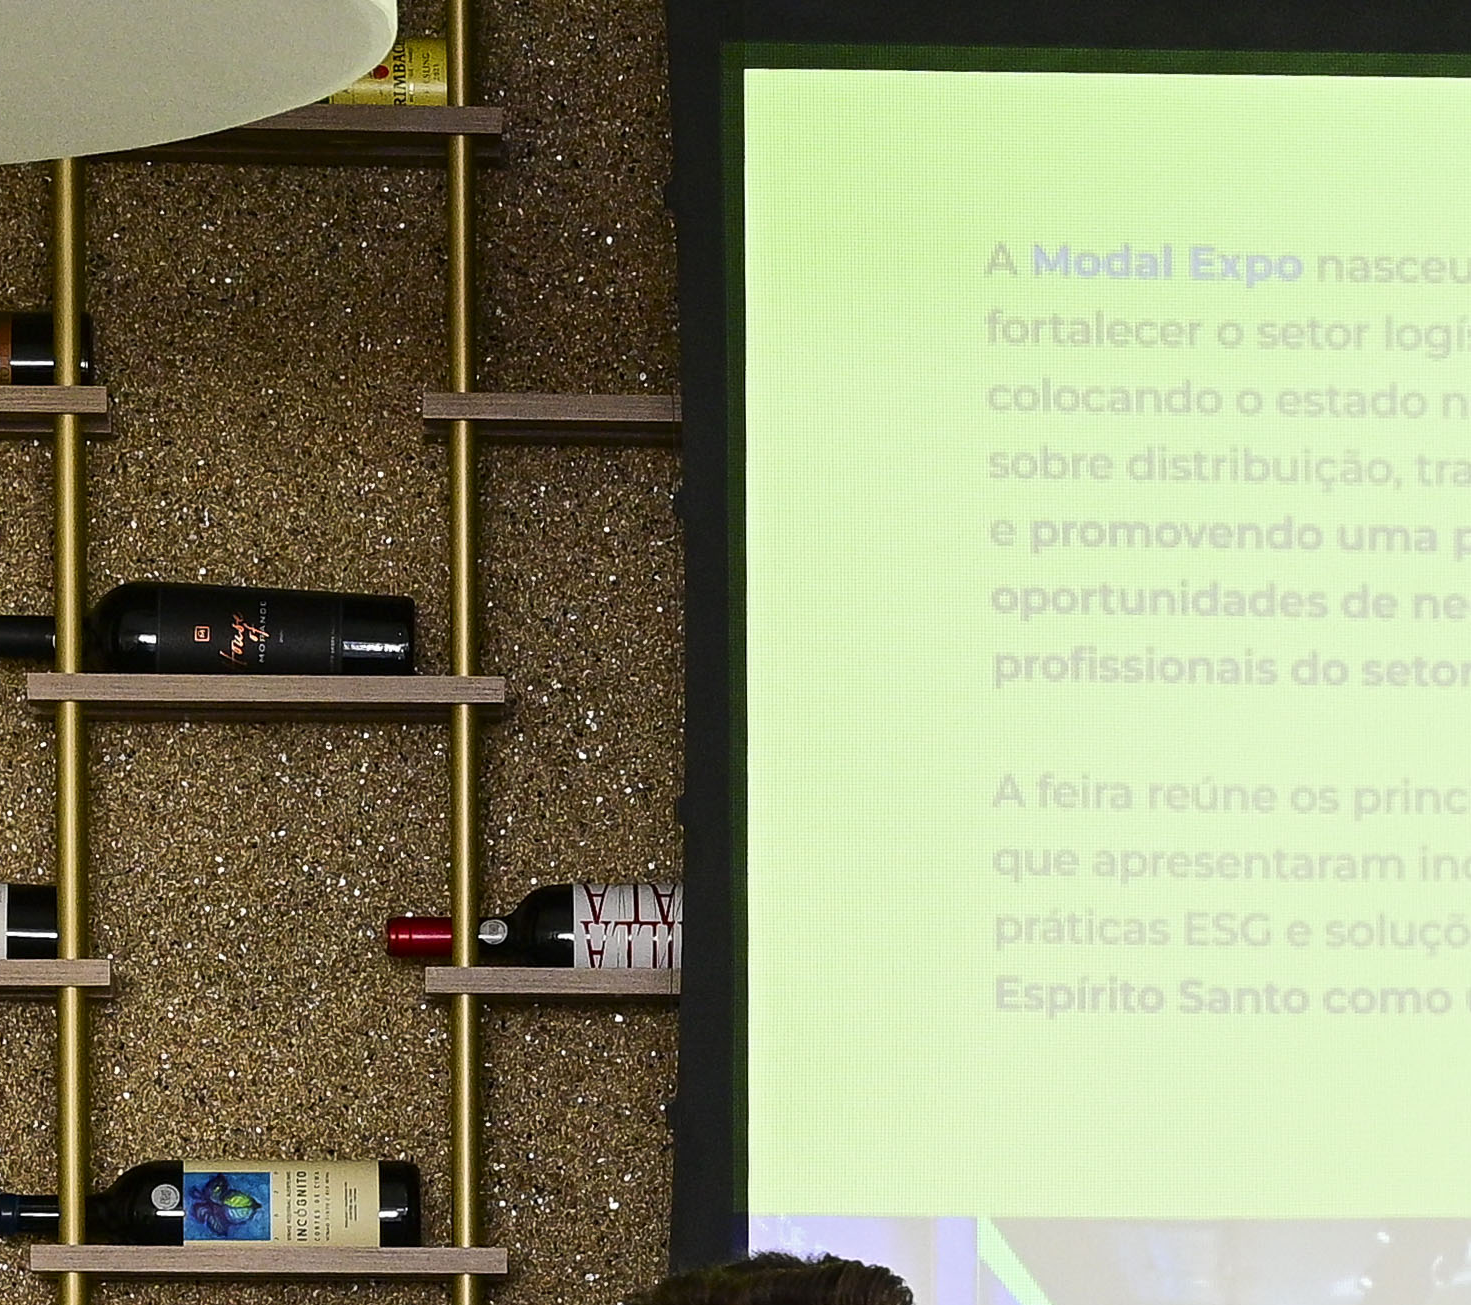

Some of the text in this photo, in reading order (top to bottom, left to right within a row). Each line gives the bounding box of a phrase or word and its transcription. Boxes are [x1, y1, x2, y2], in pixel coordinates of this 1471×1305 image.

[984, 241, 1019, 277] A
[1031, 242, 1174, 280] Modal
[1188, 244, 1305, 290] Expo
[984, 307, 1203, 349] fortalecer
[1215, 320, 1245, 350] o
[1256, 318, 1370, 351] setor
[985, 376, 1224, 416] colocando
[1234, 388, 1265, 417] o
[1275, 382, 1429, 420] estado
[987, 444, 1115, 482] sobre
[1126, 446, 1403, 494] distribuição,
[988, 518, 1017, 548] e
[1029, 514, 1325, 555] promovendo
[1336, 524, 1439, 554] uma
[989, 579, 1330, 622] oportunidades
[1340, 583, 1399, 621] de
[992, 645, 1279, 690] profissionais
[1289, 650, 1350, 688] do
[990, 772, 1026, 809] A
[1035, 771, 1134, 811] feira
[1147, 775, 1278, 814] reúne
[1288, 784, 1341, 815] os
[991, 847, 1080, 884] que
[1092, 848, 1406, 885] apresentaram
[993, 909, 1171, 952] práticas
[1184, 910, 1273, 949] ESG
[1284, 919, 1313, 949] e
[994, 974, 1167, 1020] Espírito
[1177, 977, 1311, 1016] Santo
[1321, 986, 1454, 1017] como
